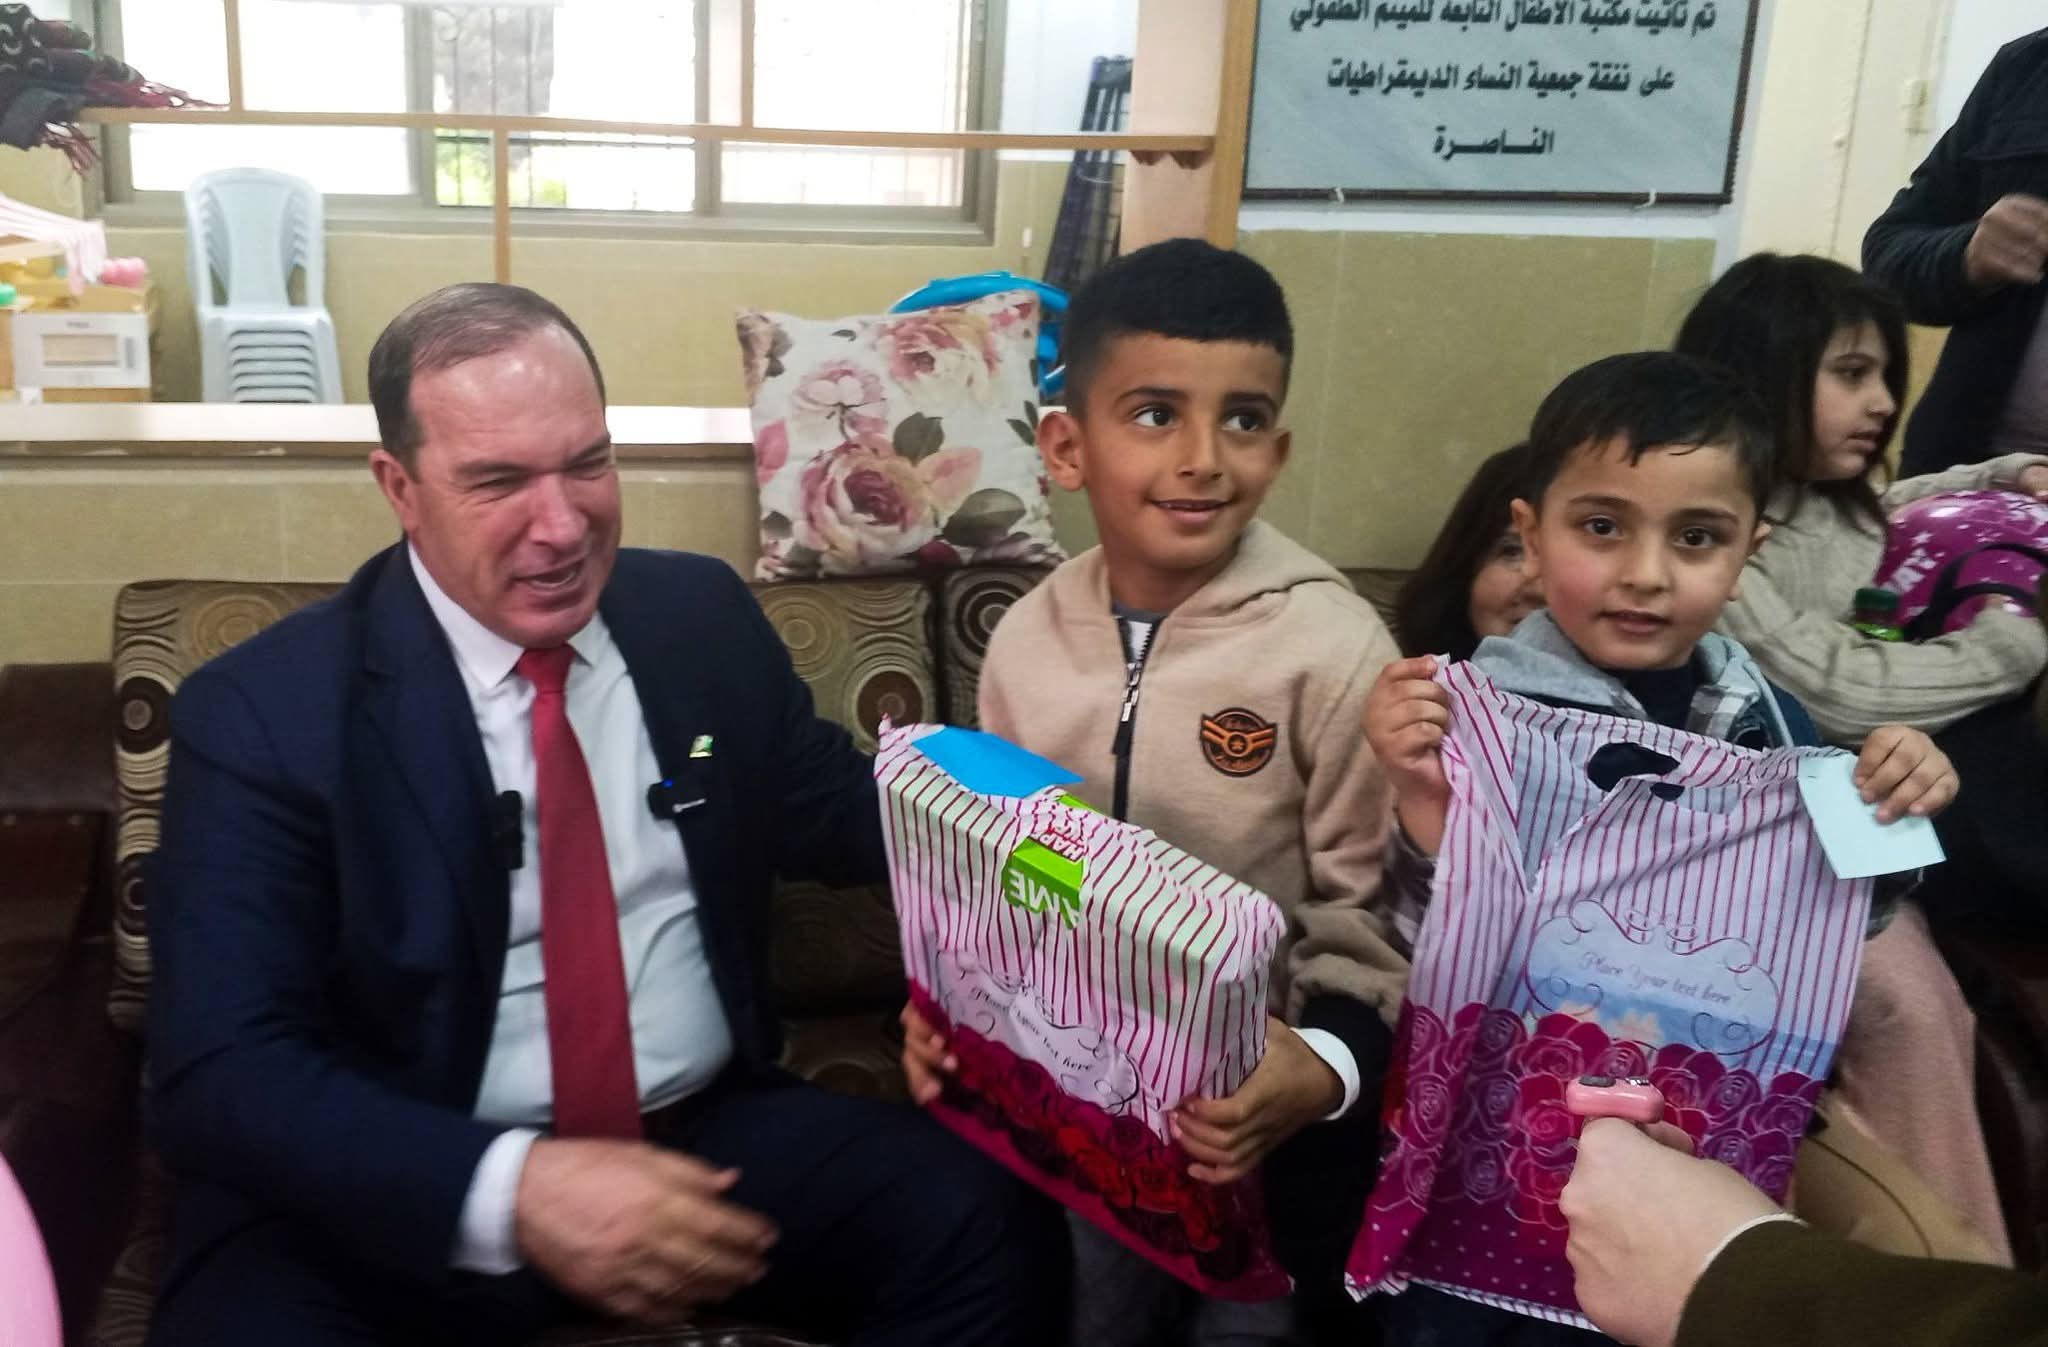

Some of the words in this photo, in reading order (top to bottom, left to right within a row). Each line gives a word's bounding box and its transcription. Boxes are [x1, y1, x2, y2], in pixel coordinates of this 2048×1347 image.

[1691, 1, 1715, 38] تم
[1327, 58, 1459, 98] الديمقراطيات
[1463, 60, 1522, 91] النساء
[1527, 60, 1584, 98] جمعية
[1588, 60, 1630, 91] نفقة
[1639, 65, 1675, 97] على
[1673, 977, 1699, 997] text
[1702, 984, 1731, 1003] here
[1062, 1056, 1094, 1071] here
